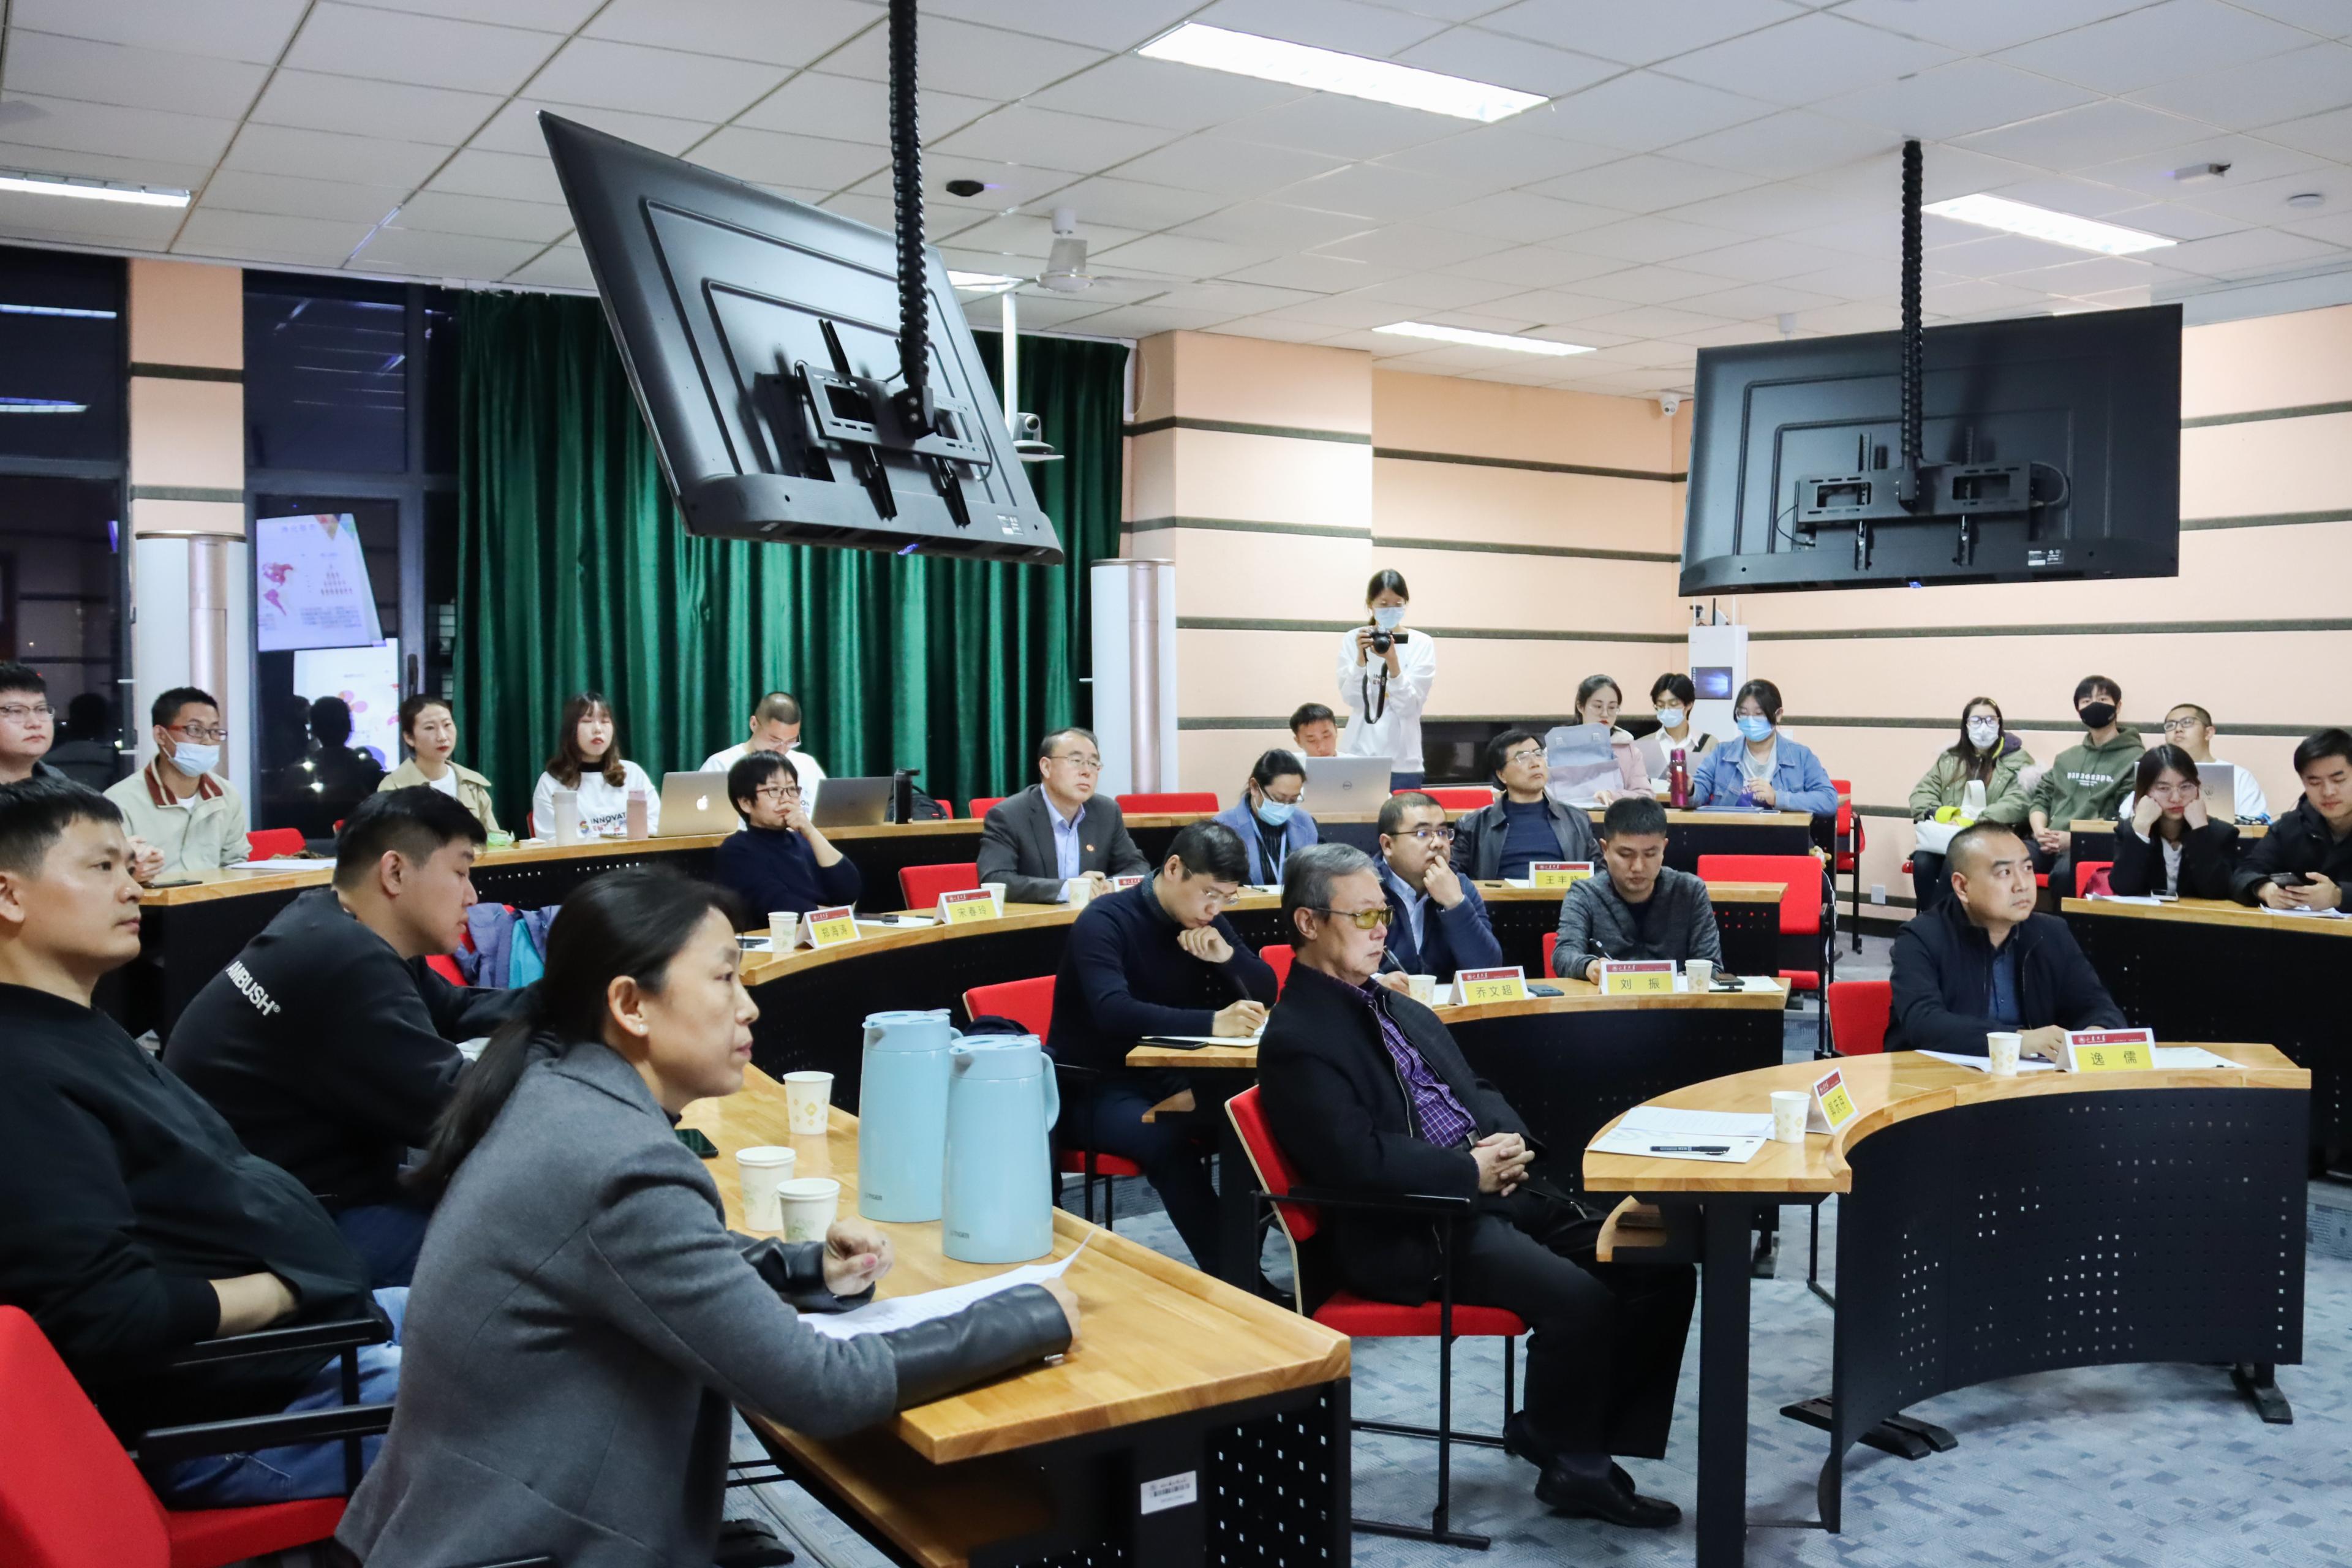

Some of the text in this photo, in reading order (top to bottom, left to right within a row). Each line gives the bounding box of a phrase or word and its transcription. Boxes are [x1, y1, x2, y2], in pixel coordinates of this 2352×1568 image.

[1476, 984, 1513, 998] 乔文超
[1620, 978, 1660, 990] 刘振
[2090, 1050, 2138, 1066] 逸儒
